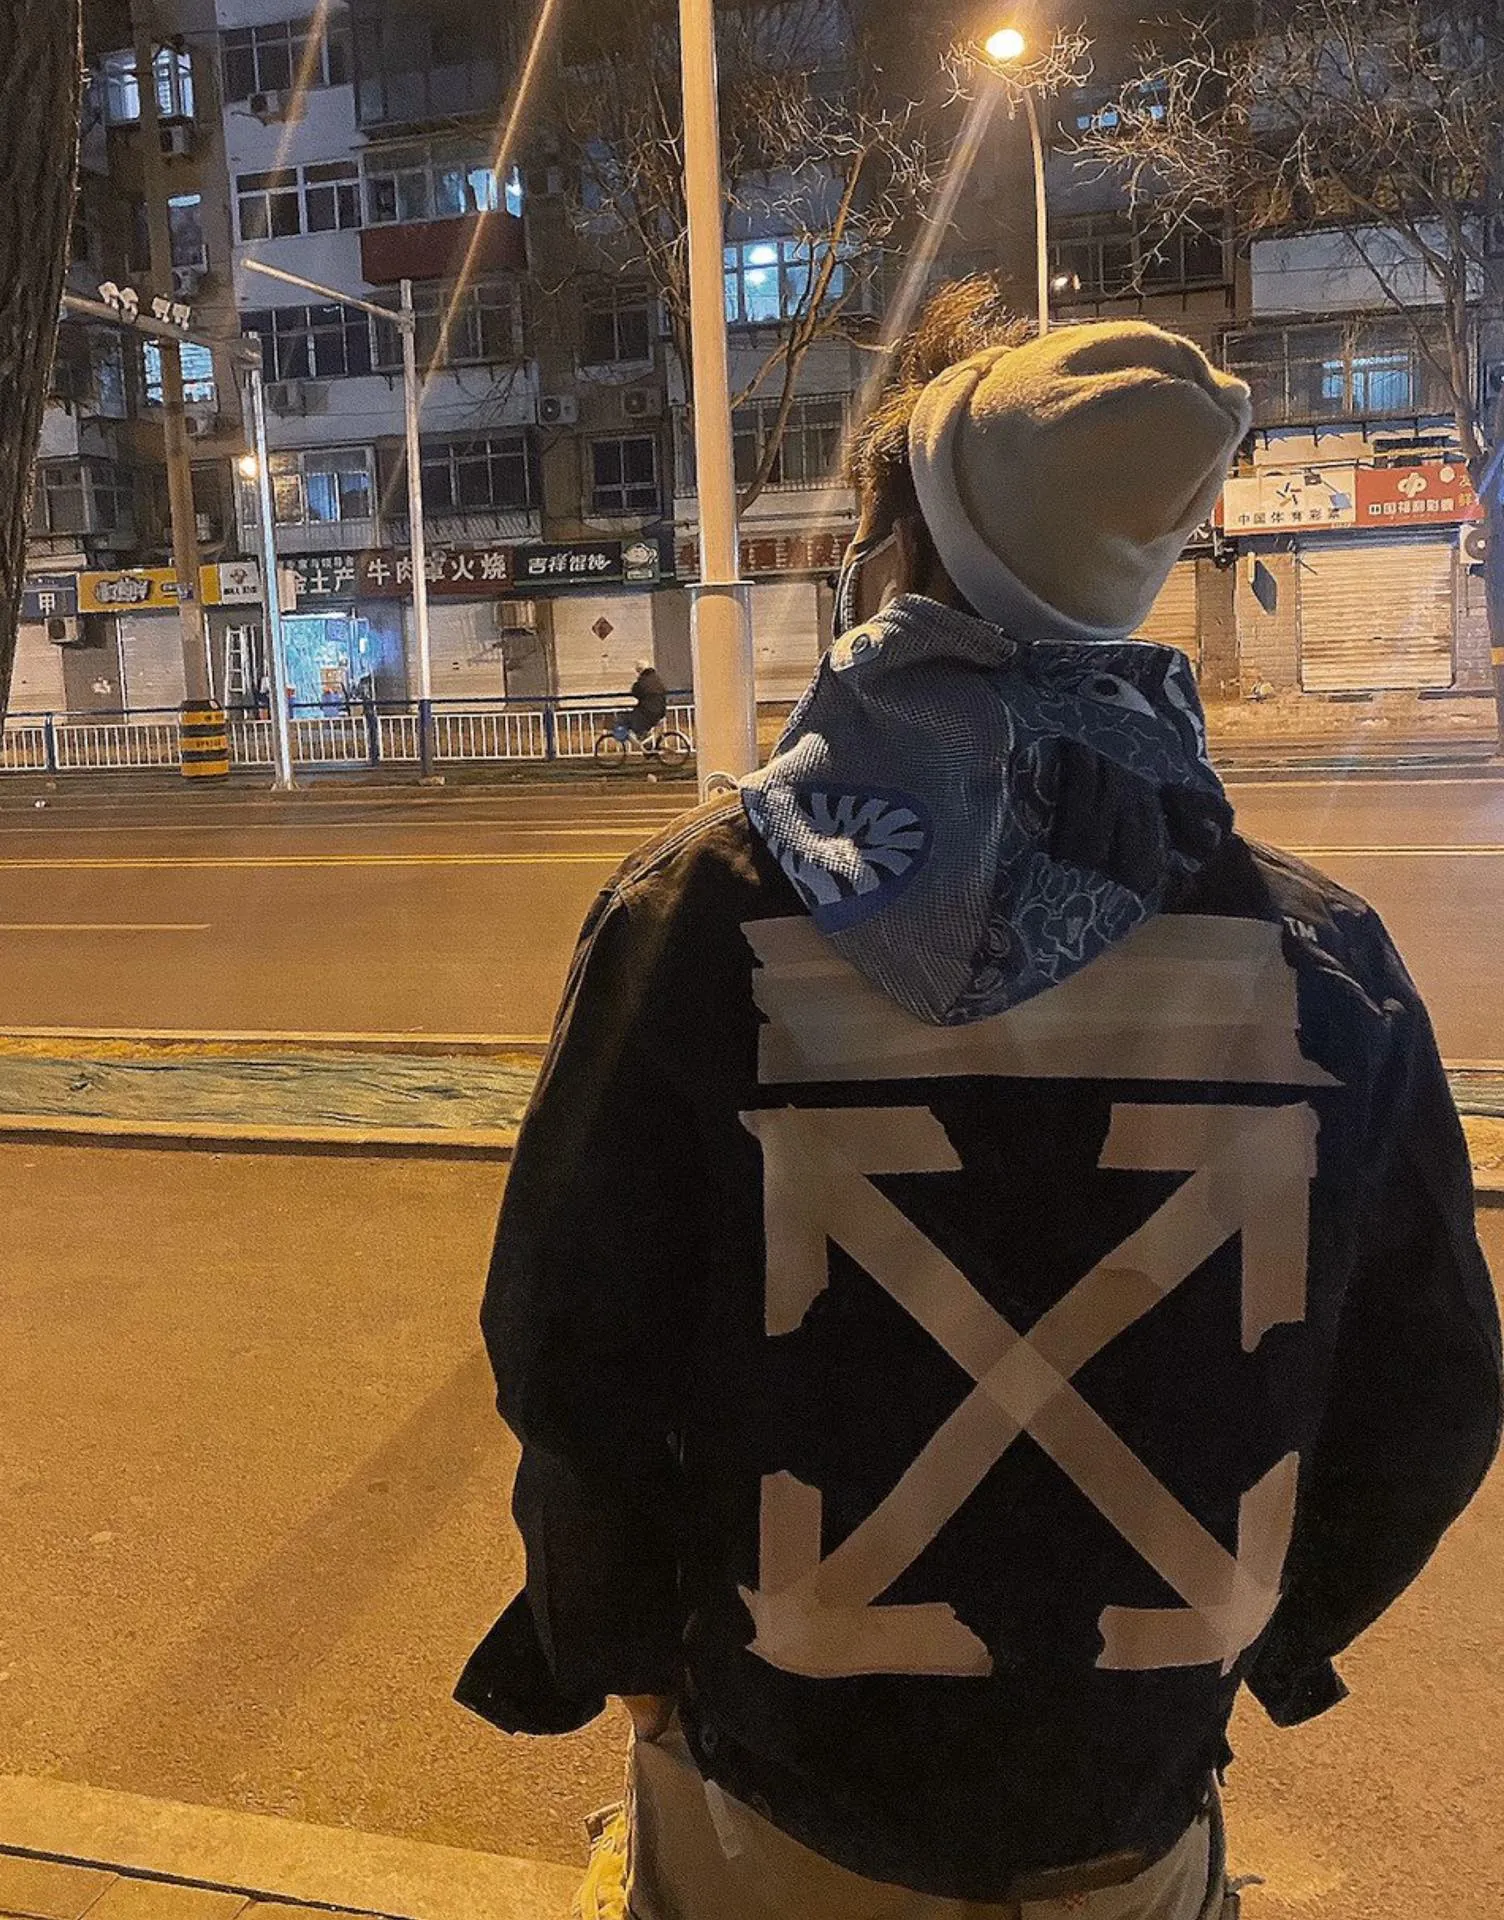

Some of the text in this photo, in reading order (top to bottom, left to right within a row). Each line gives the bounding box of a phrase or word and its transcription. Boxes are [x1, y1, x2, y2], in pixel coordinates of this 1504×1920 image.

[1238, 507, 1341, 525] 中国体育彩票
[1368, 498, 1455, 515] 中国福利彩票
[38, 592, 56, 616] 甲
[1281, 916, 1318, 942] TM
